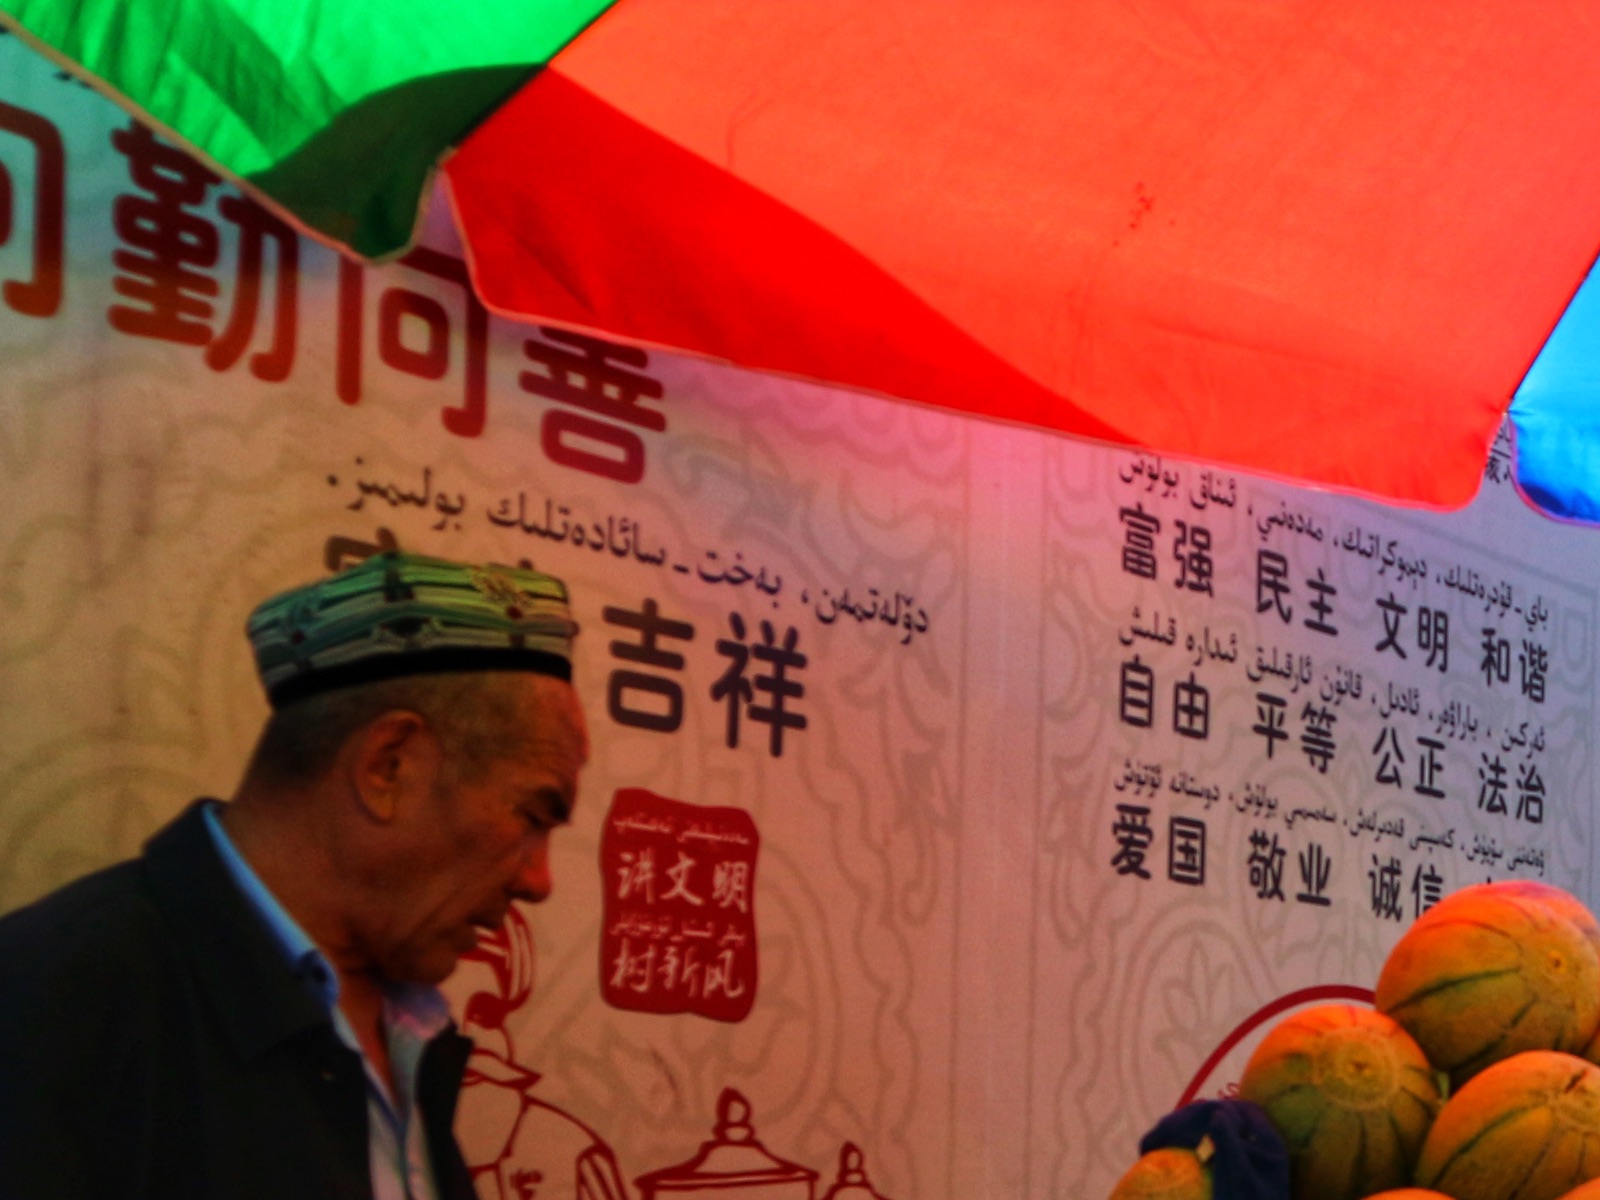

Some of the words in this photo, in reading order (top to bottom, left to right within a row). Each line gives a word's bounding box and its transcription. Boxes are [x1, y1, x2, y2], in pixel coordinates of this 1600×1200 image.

[1119, 501, 1214, 598] 富强
[1256, 547, 1338, 636] 民主
[1375, 591, 1449, 673] 文明
[1480, 626, 1549, 704] 和谐
[602, 598, 808, 758] 吉祥
[1119, 653, 1210, 741] 自由
[1253, 692, 1338, 775] 平等
[1373, 726, 1446, 800] 公正
[1477, 751, 1546, 824] 法治
[617, 846, 749, 914] 讲文明
[1110, 802, 1206, 887] 爱国
[1247, 828, 1332, 907] 敬业
[1367, 853, 1444, 922] 诚信
[609, 936, 746, 998] 树新风
